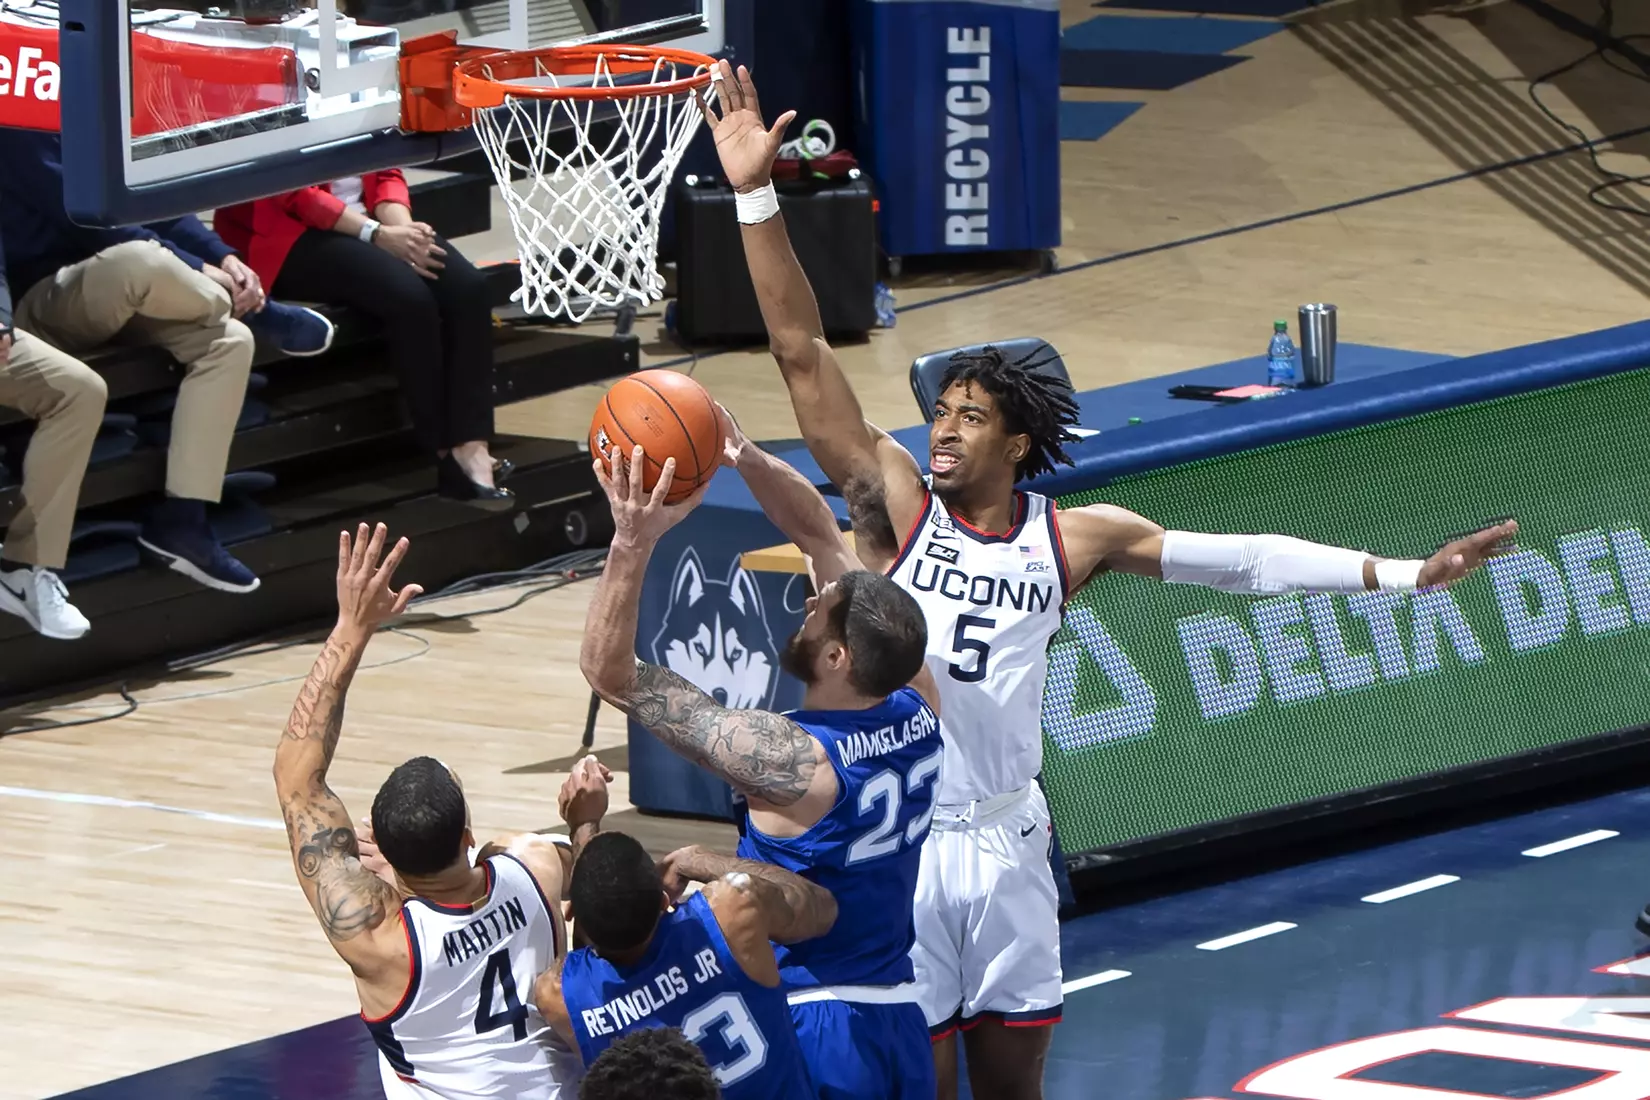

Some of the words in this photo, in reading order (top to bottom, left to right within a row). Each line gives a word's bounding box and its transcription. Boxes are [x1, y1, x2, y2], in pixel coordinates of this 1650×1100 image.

[944, 26, 991, 247] RECYCLE
[911, 558, 1053, 614] UCONN
[947, 613, 996, 684] 5
[1177, 588, 1486, 720] DELTA
[845, 745, 944, 868] 23
[443, 896, 528, 968] MARTIN
[474, 947, 529, 1042] 4
[581, 966, 689, 1039] REYNOLDS
[694, 948, 722, 984] JR
[681, 991, 769, 1089] 3
